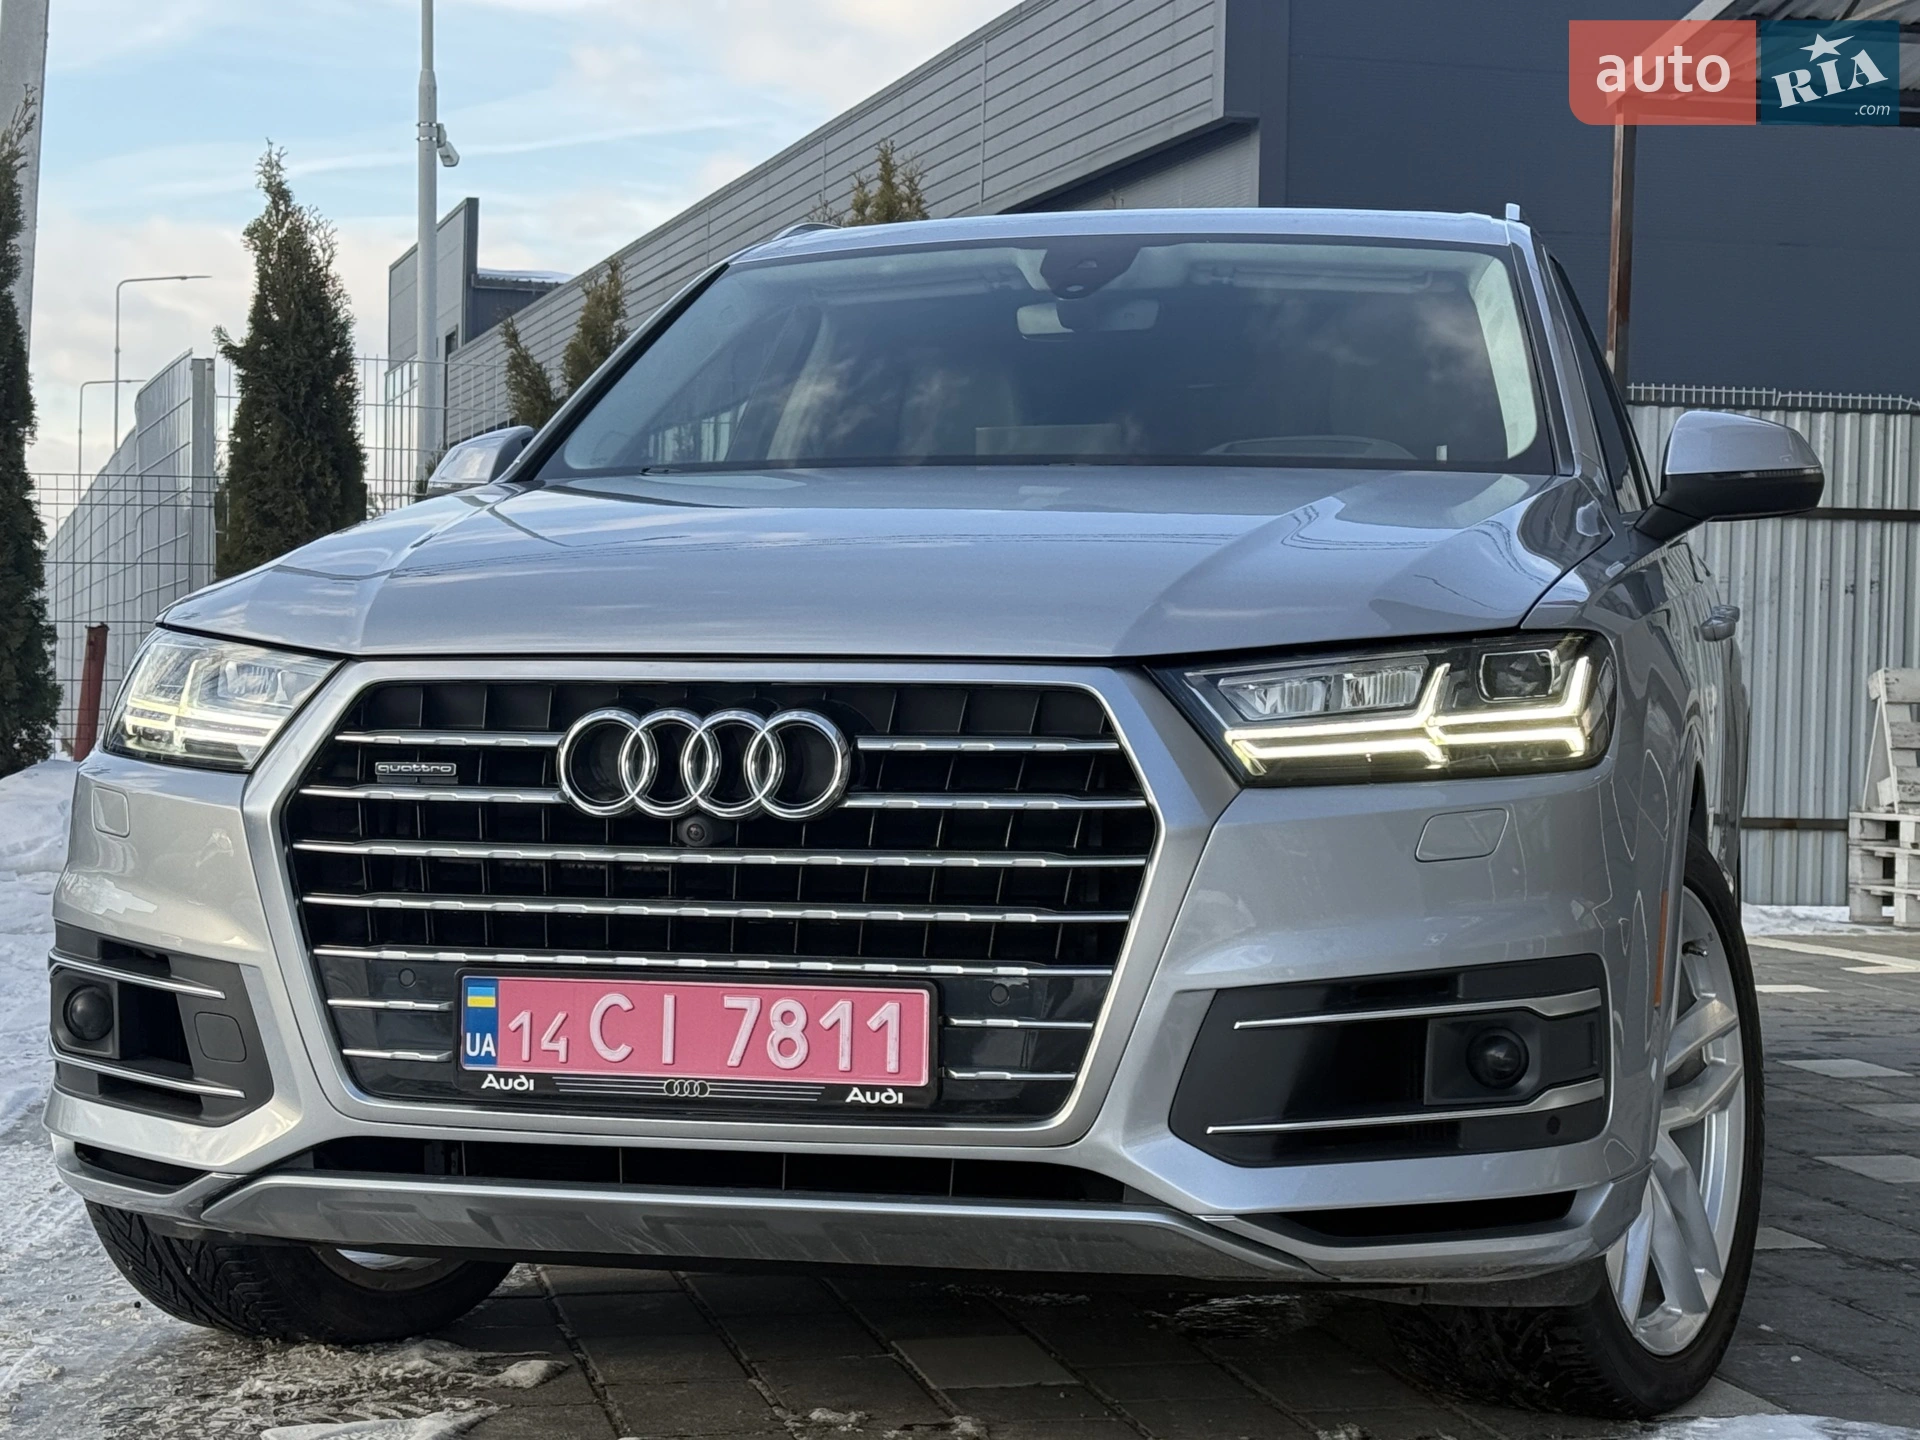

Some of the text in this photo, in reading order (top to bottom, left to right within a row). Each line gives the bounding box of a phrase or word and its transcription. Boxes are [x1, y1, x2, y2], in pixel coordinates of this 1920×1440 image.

[377, 764, 452, 774] quattro
[507, 1010, 569, 1063] 14
[723, 995, 901, 1073] 7811
[465, 1032, 497, 1058] UA
[481, 1073, 535, 1092] Audi
[845, 1087, 904, 1105] Audi
